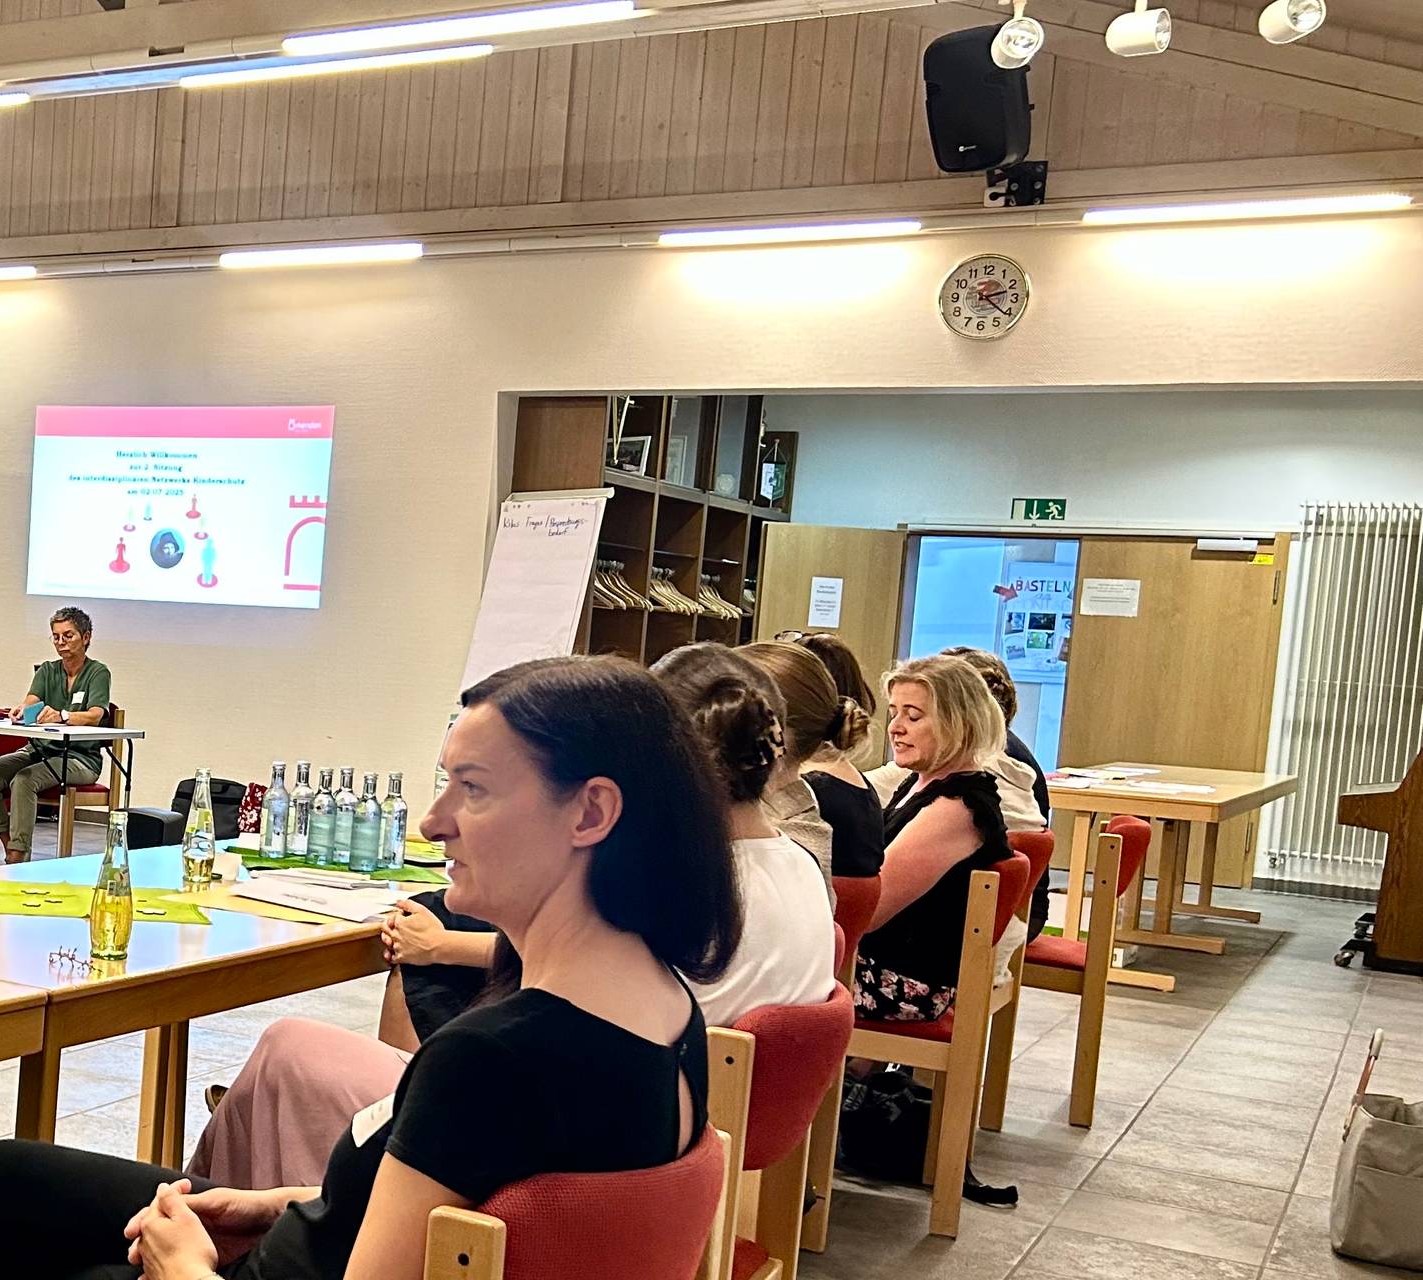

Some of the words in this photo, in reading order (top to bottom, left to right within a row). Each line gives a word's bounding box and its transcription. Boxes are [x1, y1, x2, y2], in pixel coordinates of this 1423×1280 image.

[968, 268, 978, 279] 11
[983, 264, 995, 276] 12
[1001, 268, 1007, 279] 1
[955, 278, 968, 289] 10
[1008, 279, 1017, 289] 2
[951, 292, 960, 303] 9
[1010, 292, 1019, 303] 3
[952, 306, 962, 317] 8
[1004, 307, 1013, 317] 4
[963, 316, 973, 327] 7
[976, 320, 985, 331] 6
[992, 316, 1001, 327] 5
[1016, 579, 1071, 593] BASTELN
